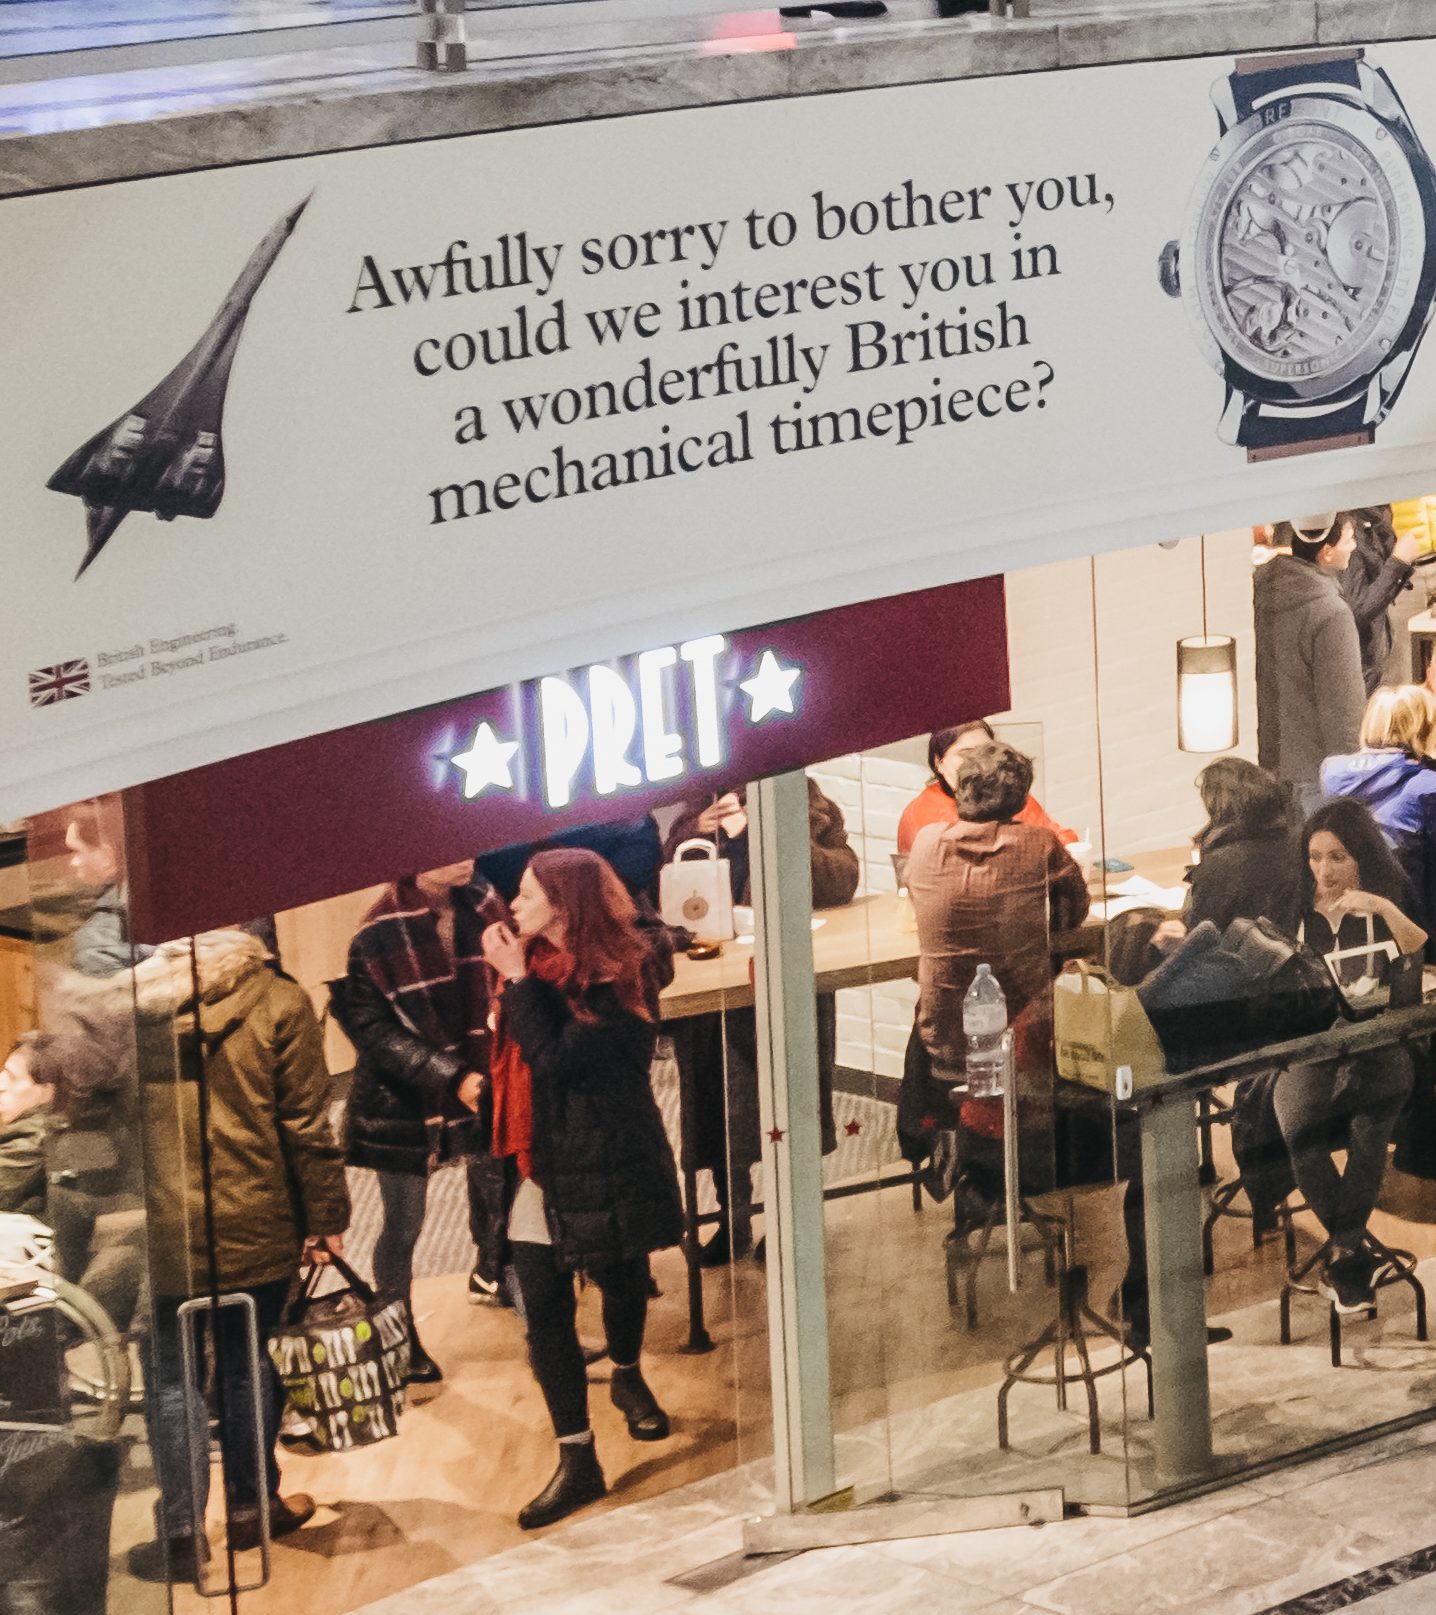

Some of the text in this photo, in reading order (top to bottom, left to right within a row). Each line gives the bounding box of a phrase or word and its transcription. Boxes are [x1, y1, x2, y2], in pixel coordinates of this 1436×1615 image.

[345, 173, 1114, 313] Awfully sorry to bother you,
[413, 232, 1062, 377] could we interest you in
[428, 360, 1055, 525] mechanical timepiece?
[454, 300, 1031, 445] a wonderfully British
[540, 634, 725, 808] PRET
